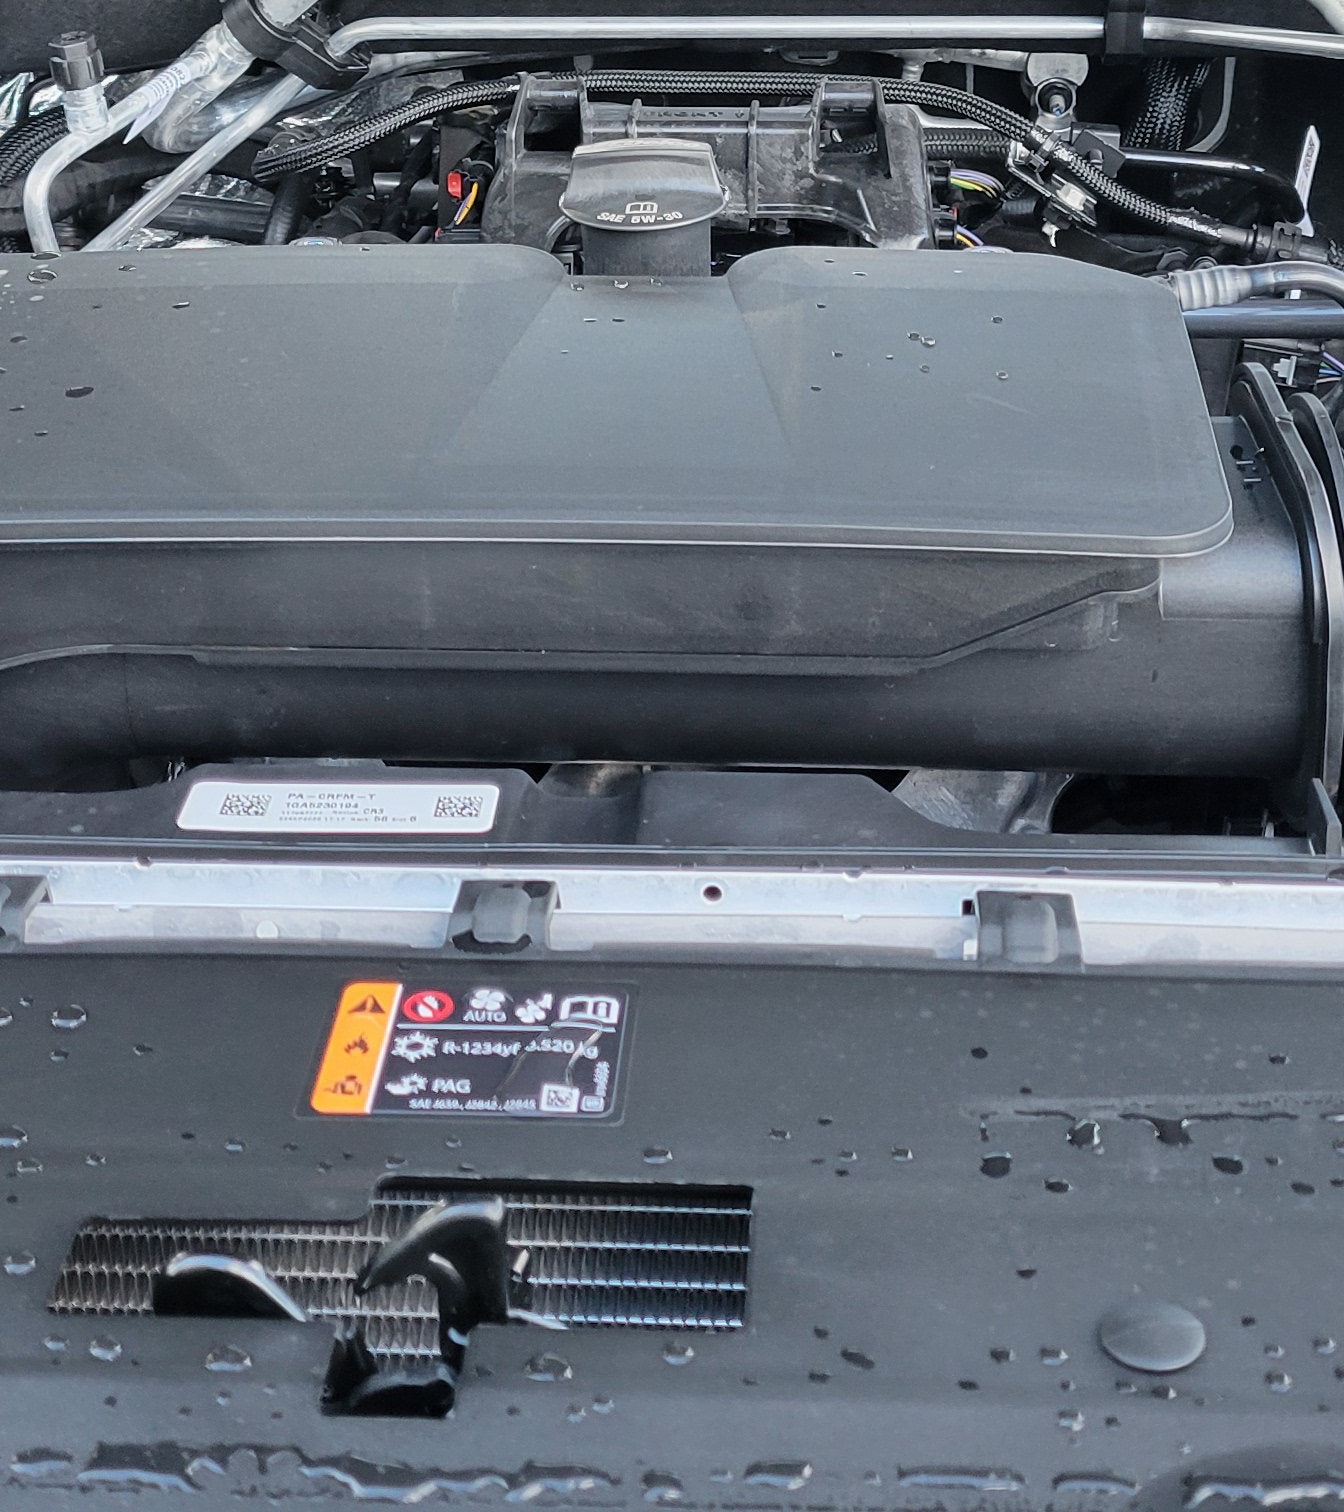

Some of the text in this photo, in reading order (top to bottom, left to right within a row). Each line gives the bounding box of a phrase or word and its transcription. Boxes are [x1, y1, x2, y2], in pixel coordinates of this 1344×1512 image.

[596, 211, 683, 224] SAE 5W-30
[463, 1010, 507, 1022] AUTO
[442, 1040, 522, 1057] R-1234yf
[432, 1078, 471, 1094] PAG
